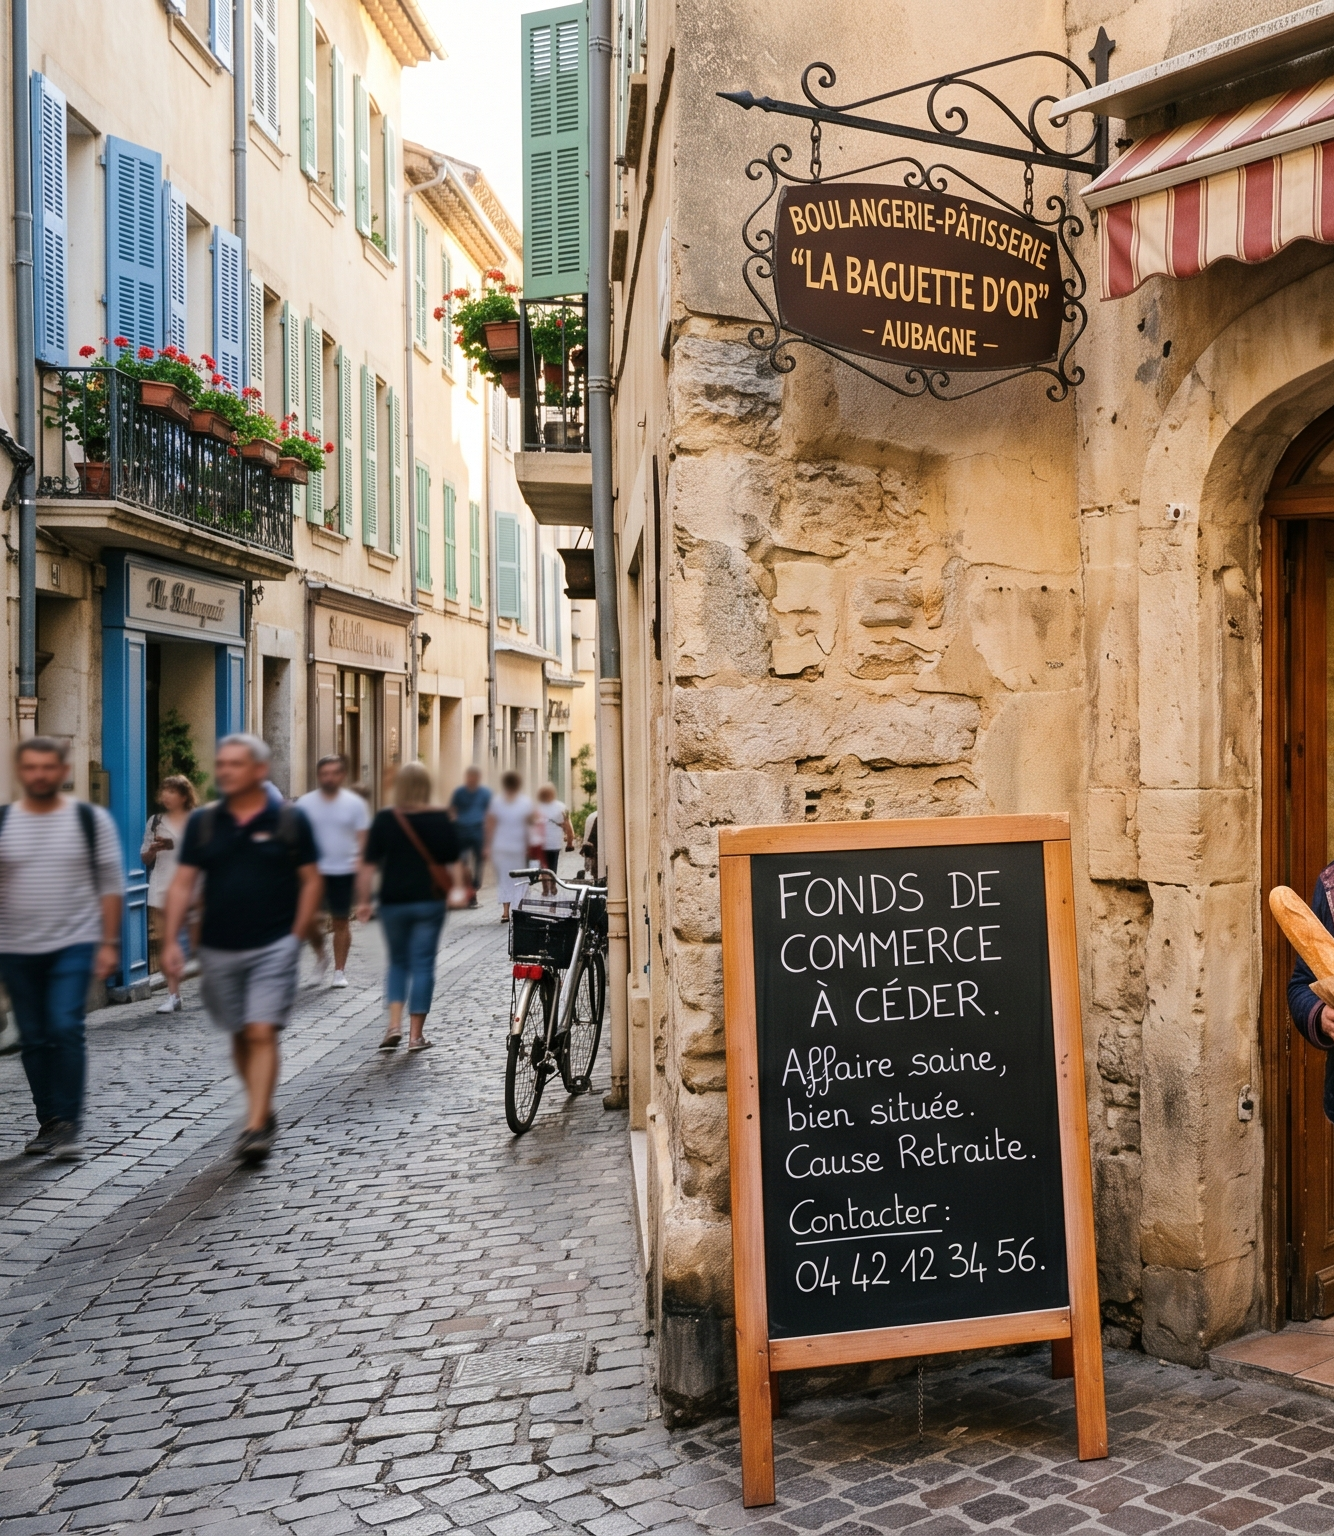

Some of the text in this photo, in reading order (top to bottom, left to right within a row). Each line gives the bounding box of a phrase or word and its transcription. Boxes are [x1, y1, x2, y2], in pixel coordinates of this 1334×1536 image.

[789, 199, 1051, 270] BOULANGERIE-PÂTISSERIE
[791, 247, 839, 292] “LA
[846, 255, 975, 311] BAGUETTE
[881, 319, 977, 357] AUBAGNE
[778, 870, 1001, 919] FONDS DE
[780, 925, 1002, 972] COMMERCE
[811, 978, 1000, 1028] À CÉDER.
[782, 1045, 1007, 1099] Affaire saine,
[787, 1091, 975, 1133] bien située.
[785, 1127, 1037, 1179] Cause Retraite.
[795, 1236, 1046, 1296] 04 42 12 34 56.
